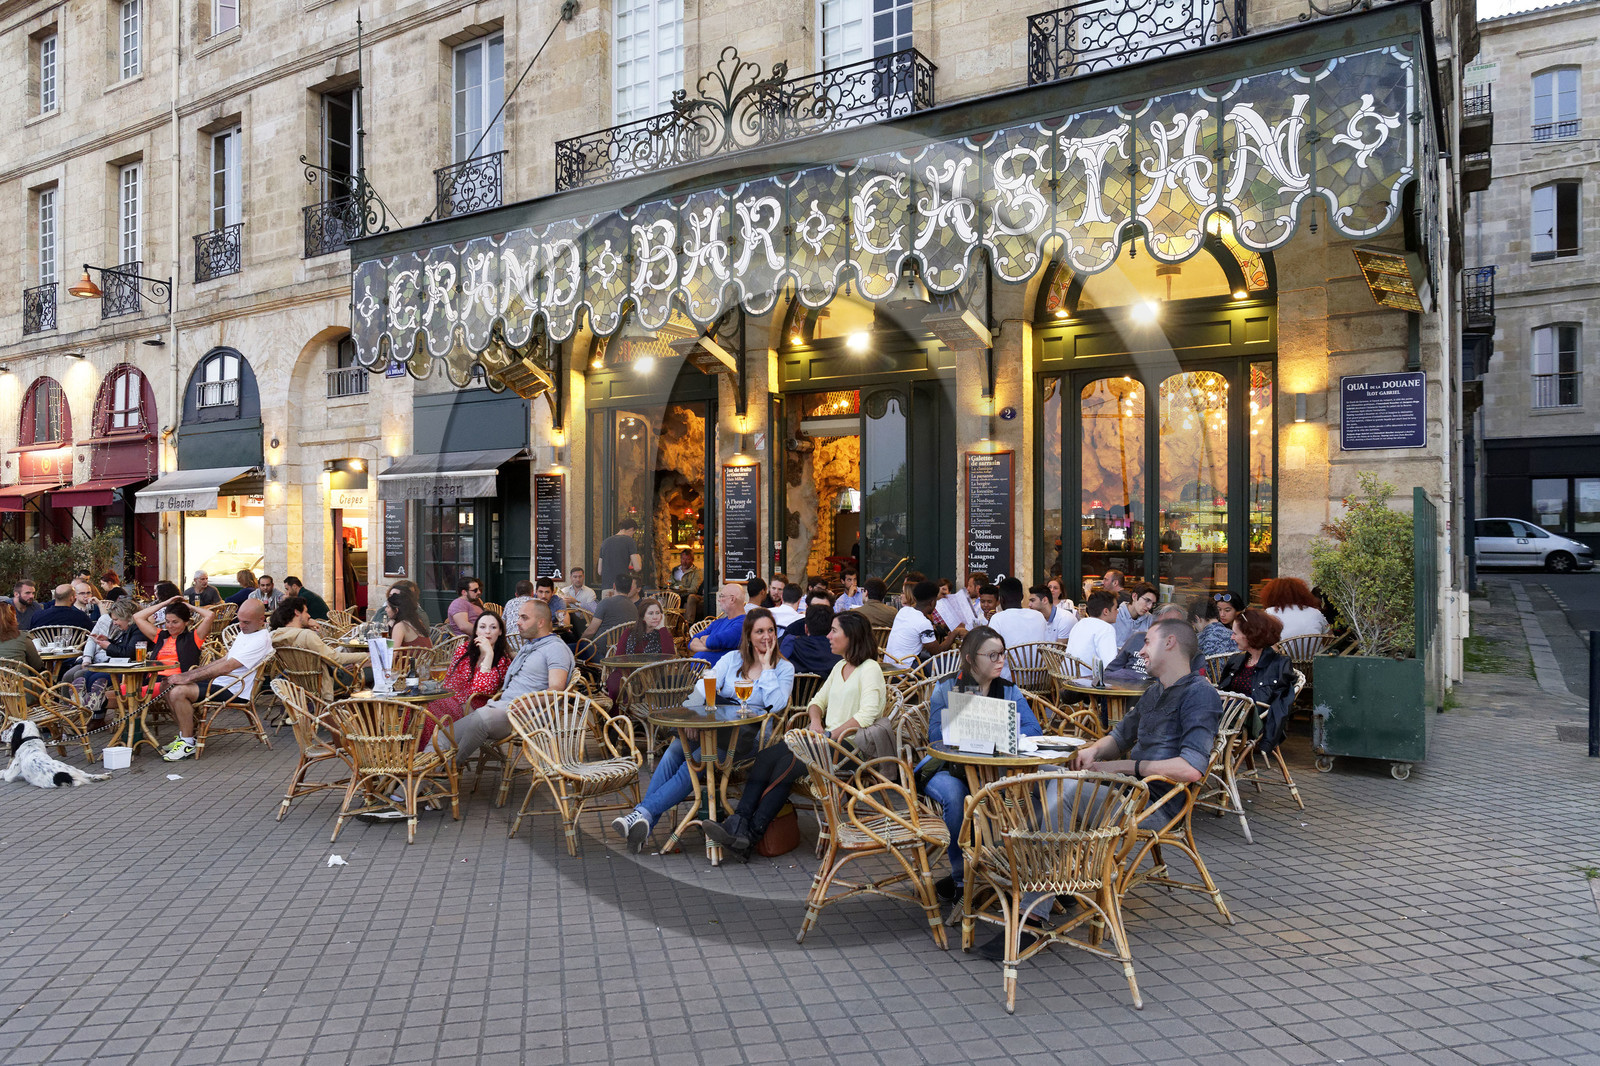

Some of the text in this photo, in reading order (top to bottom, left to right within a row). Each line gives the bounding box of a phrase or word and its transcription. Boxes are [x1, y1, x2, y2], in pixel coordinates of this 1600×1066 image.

[388, 238, 581, 330] GRAND
[631, 196, 785, 295] BAR
[1346, 383, 1369, 391] QUAI
[1382, 379, 1421, 389] DOUANE
[1004, 408, 1011, 418] 2
[156, 496, 195, 509] Le Glacier
[971, 528, 992, 536] Croque
